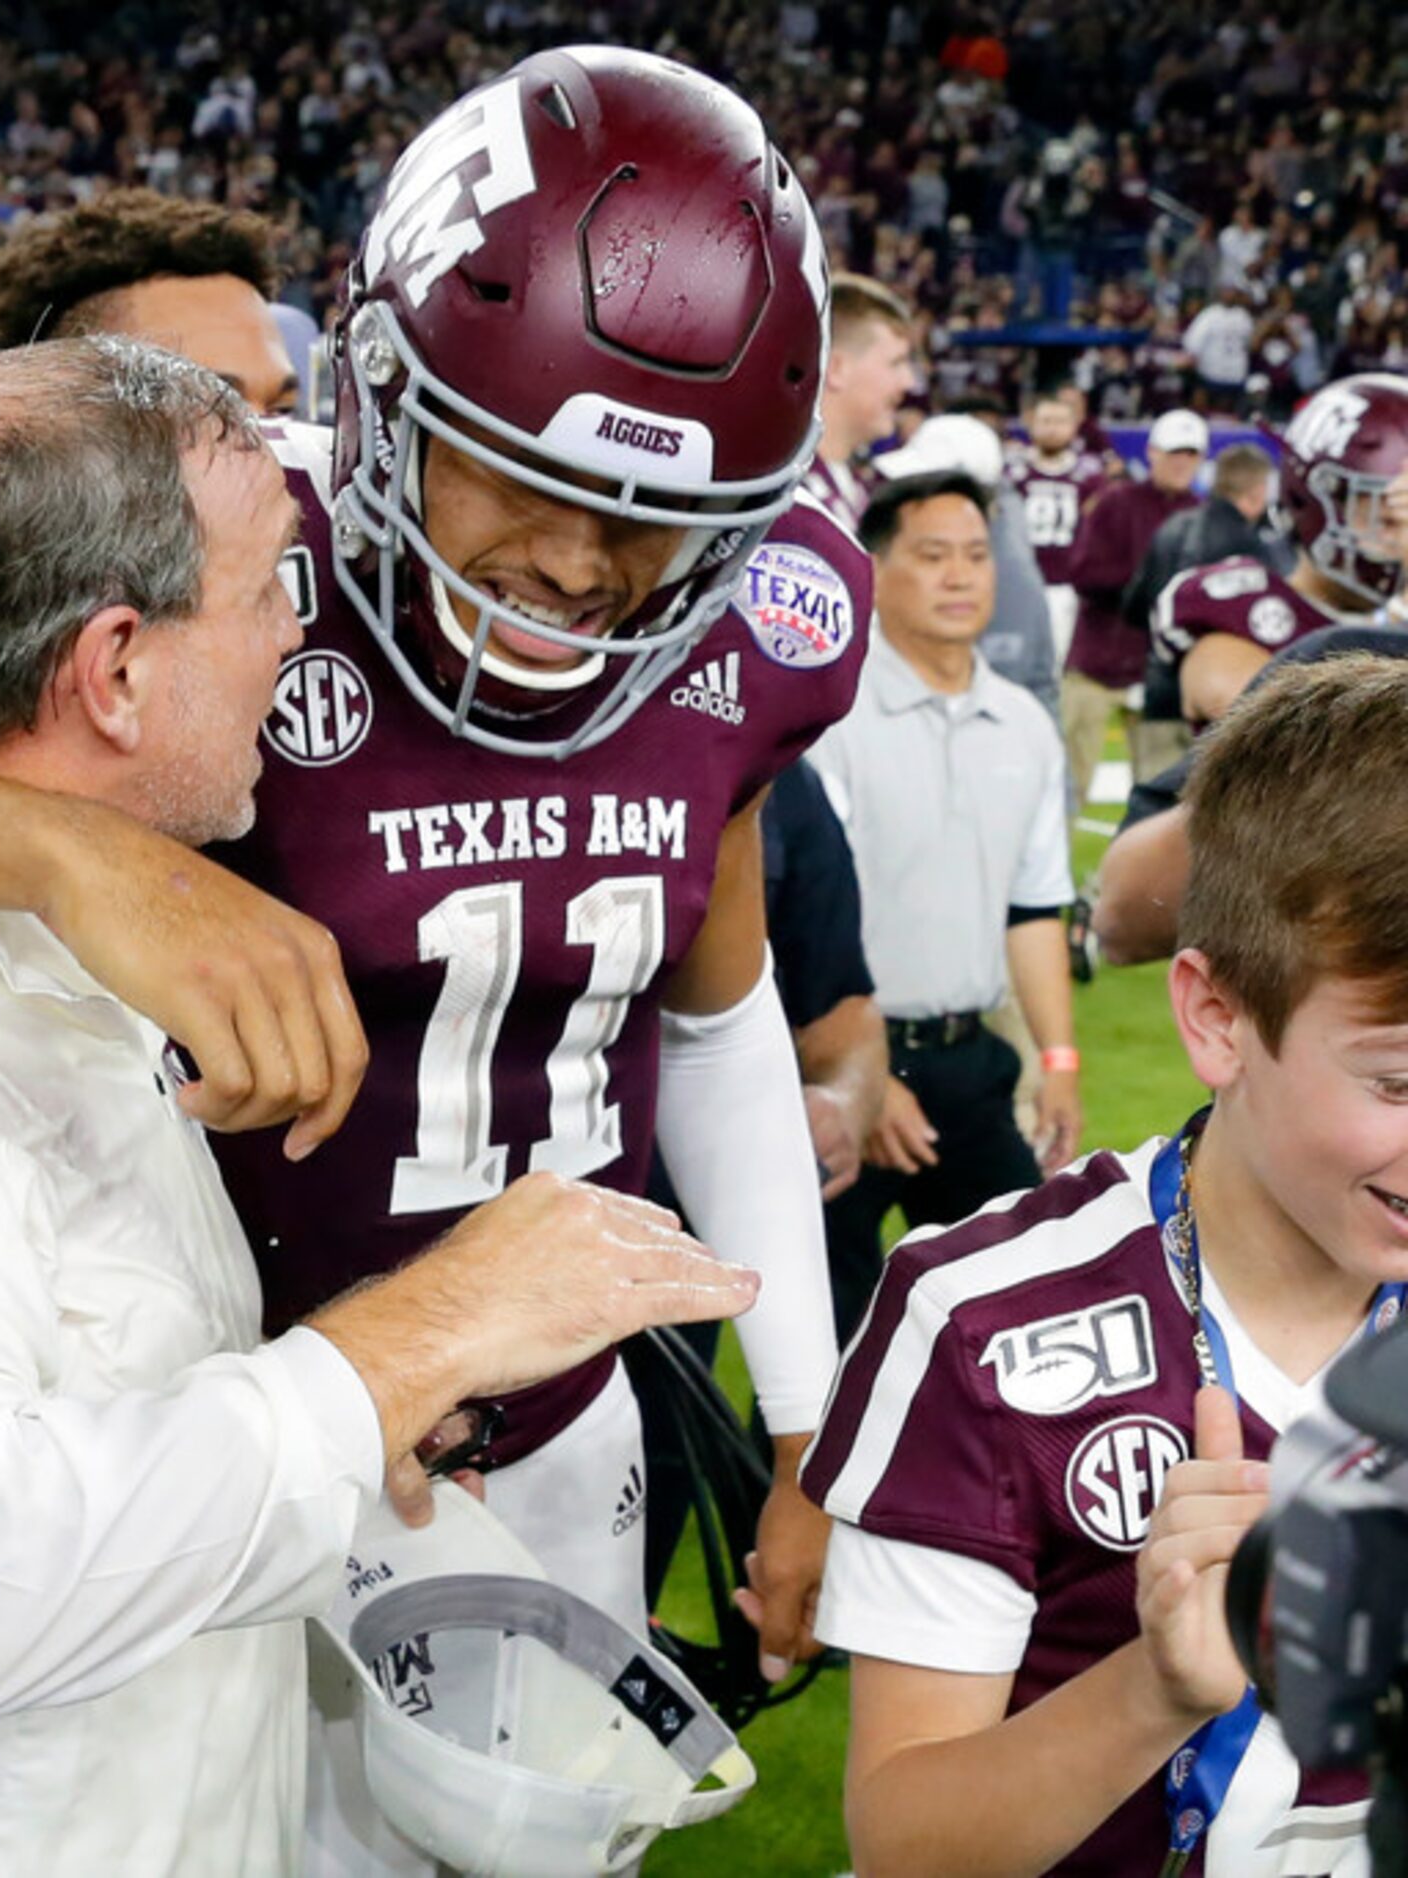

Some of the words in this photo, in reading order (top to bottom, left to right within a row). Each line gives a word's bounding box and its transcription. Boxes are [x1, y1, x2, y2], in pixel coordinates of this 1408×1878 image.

[596, 411, 684, 457] AGGIES
[747, 566, 845, 643] TEXAS
[273, 658, 363, 759] SEC
[670, 686, 746, 725] adidas
[369, 796, 567, 873] TEXAS
[586, 795, 688, 859] A&M
[390, 875, 665, 1215] 11
[990, 1297, 1156, 1410] 150
